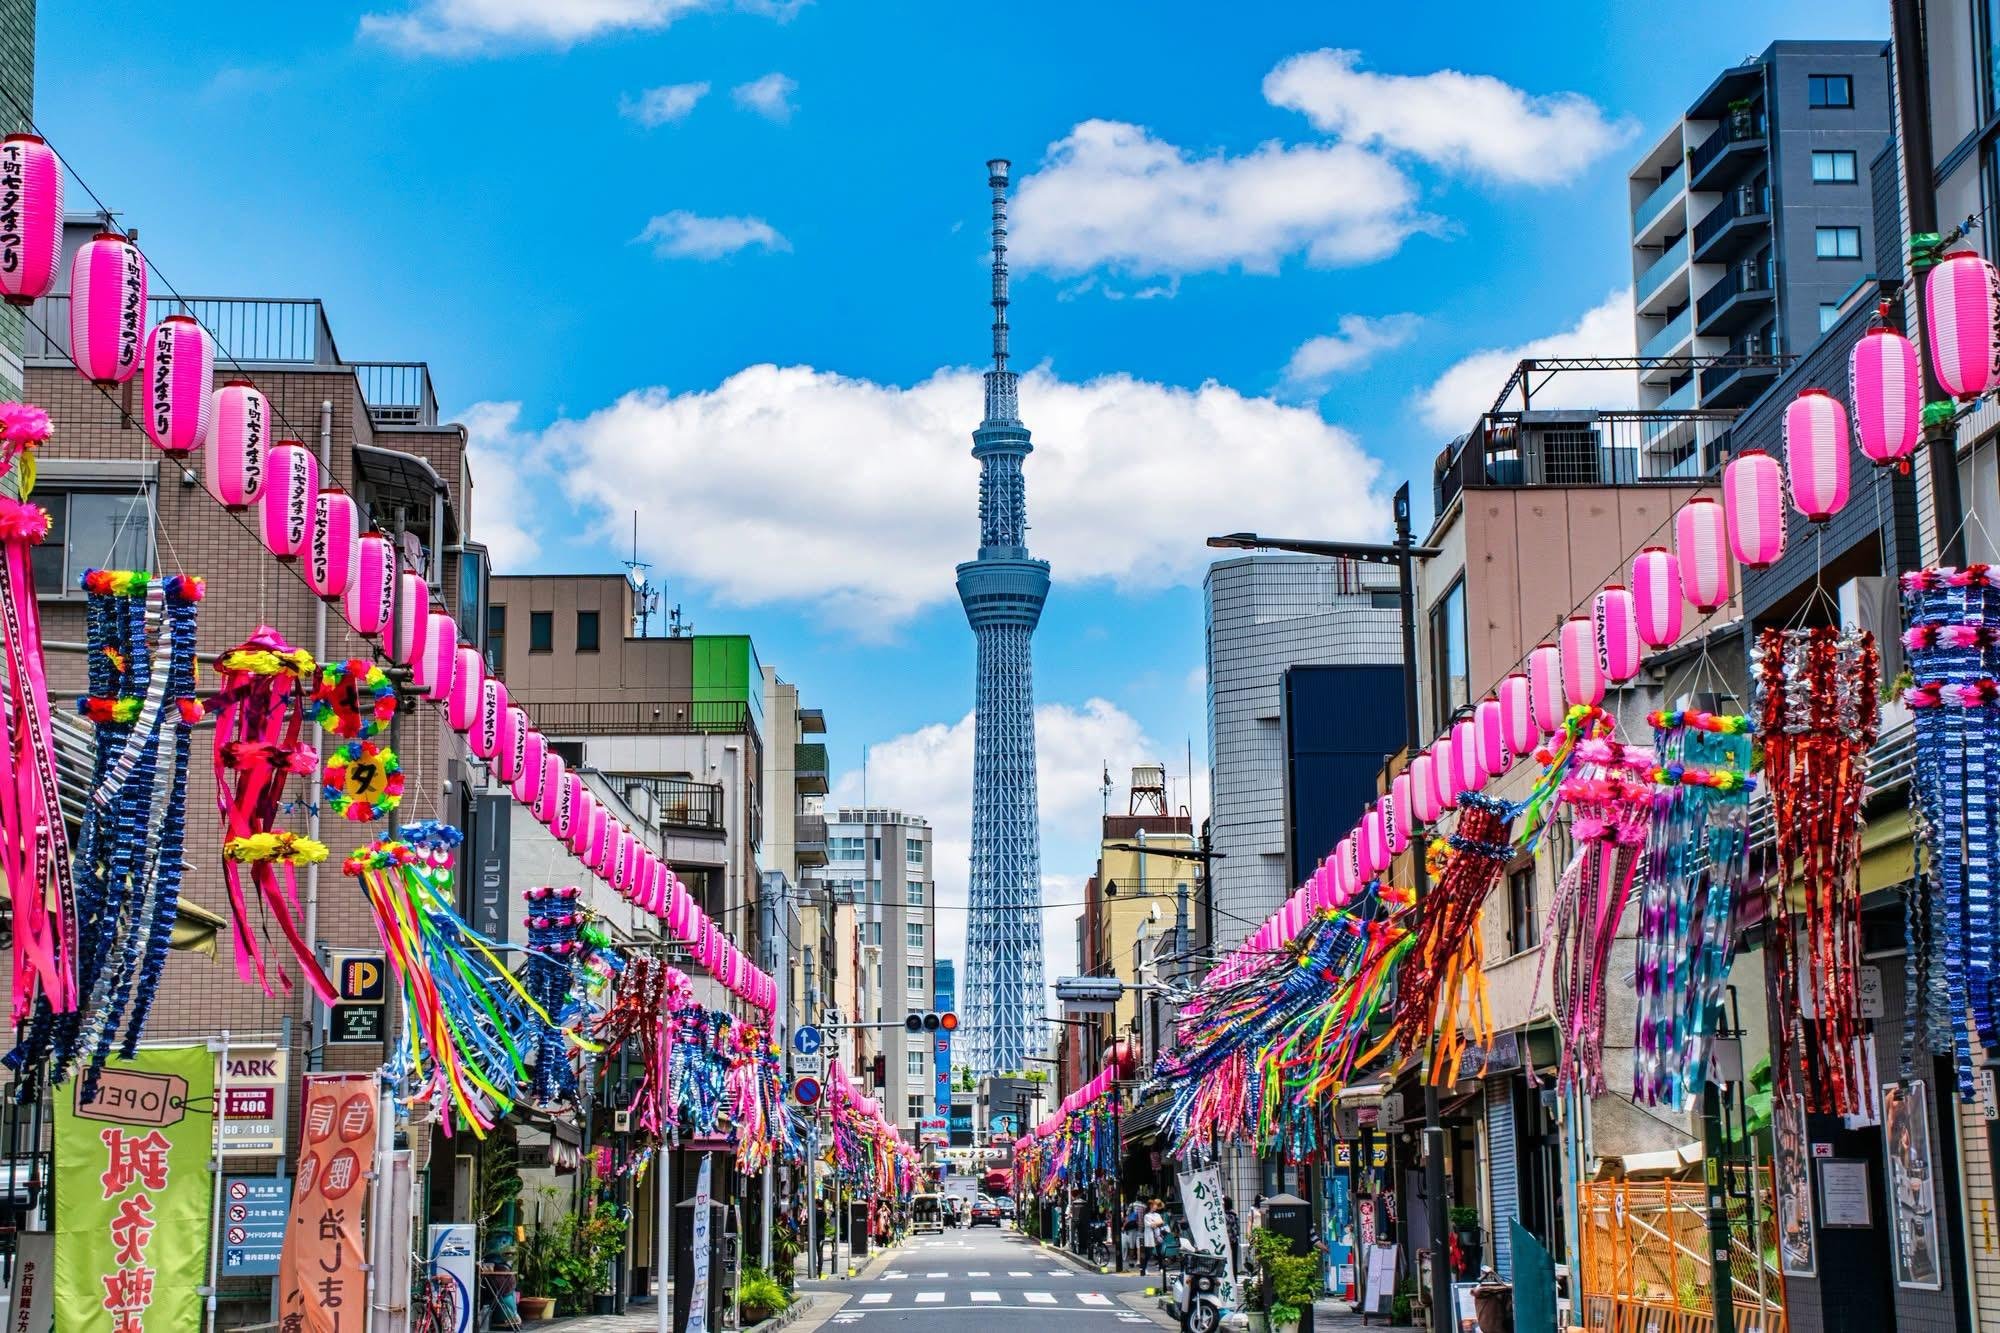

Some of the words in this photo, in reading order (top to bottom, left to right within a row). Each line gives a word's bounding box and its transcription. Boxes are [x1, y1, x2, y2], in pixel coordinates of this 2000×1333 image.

[1, 147, 22, 273] 下町七夕まつり
[120, 247, 141, 367] 下町七夕まつり
[155, 327, 173, 435] 下町七夕まつり
[245, 396, 261, 495] 下町七夕まつり
[290, 452, 306, 544] 下町七夕まつり
[314, 498, 328, 583] 下町七夕まつり
[380, 543, 396, 624] 下町七夕まつり
[1596, 595, 1608, 671] 下町七夕まつり
[485, 684, 496, 750] 下町七夕まつり
[516, 712, 525, 773] 下町七夕まつり
[561, 776, 571, 831] 下町七夕まつり
[1385, 798, 1395, 848] 下町七夕まつり
[343, 1007, 378, 1040] 空
